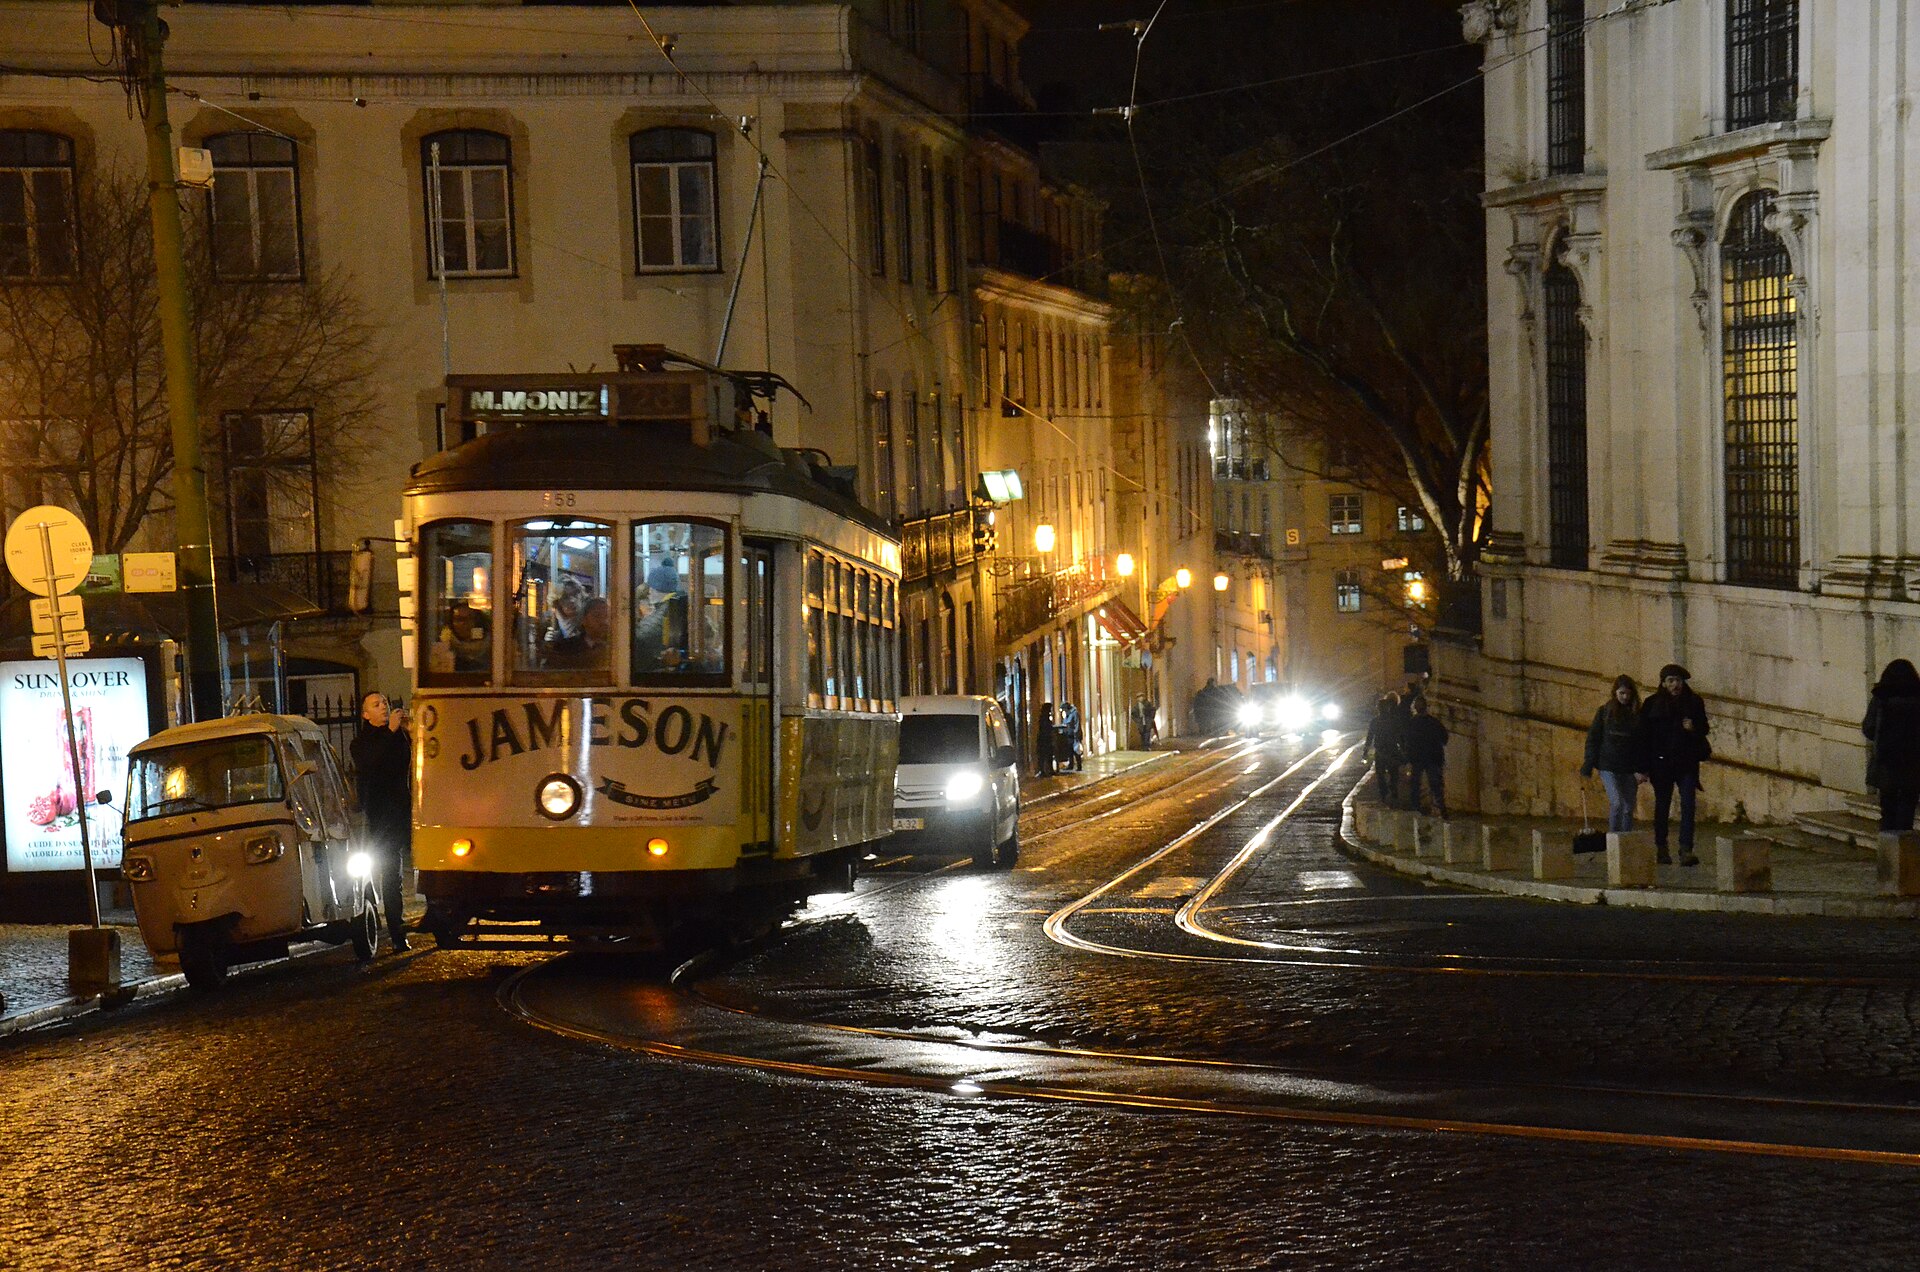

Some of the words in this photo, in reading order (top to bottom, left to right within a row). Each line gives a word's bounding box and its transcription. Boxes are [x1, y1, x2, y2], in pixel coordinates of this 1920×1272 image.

[470, 390, 597, 411] M.MONIZ
[1288, 530, 1298, 543] S
[460, 697, 729, 771] JAMESON
